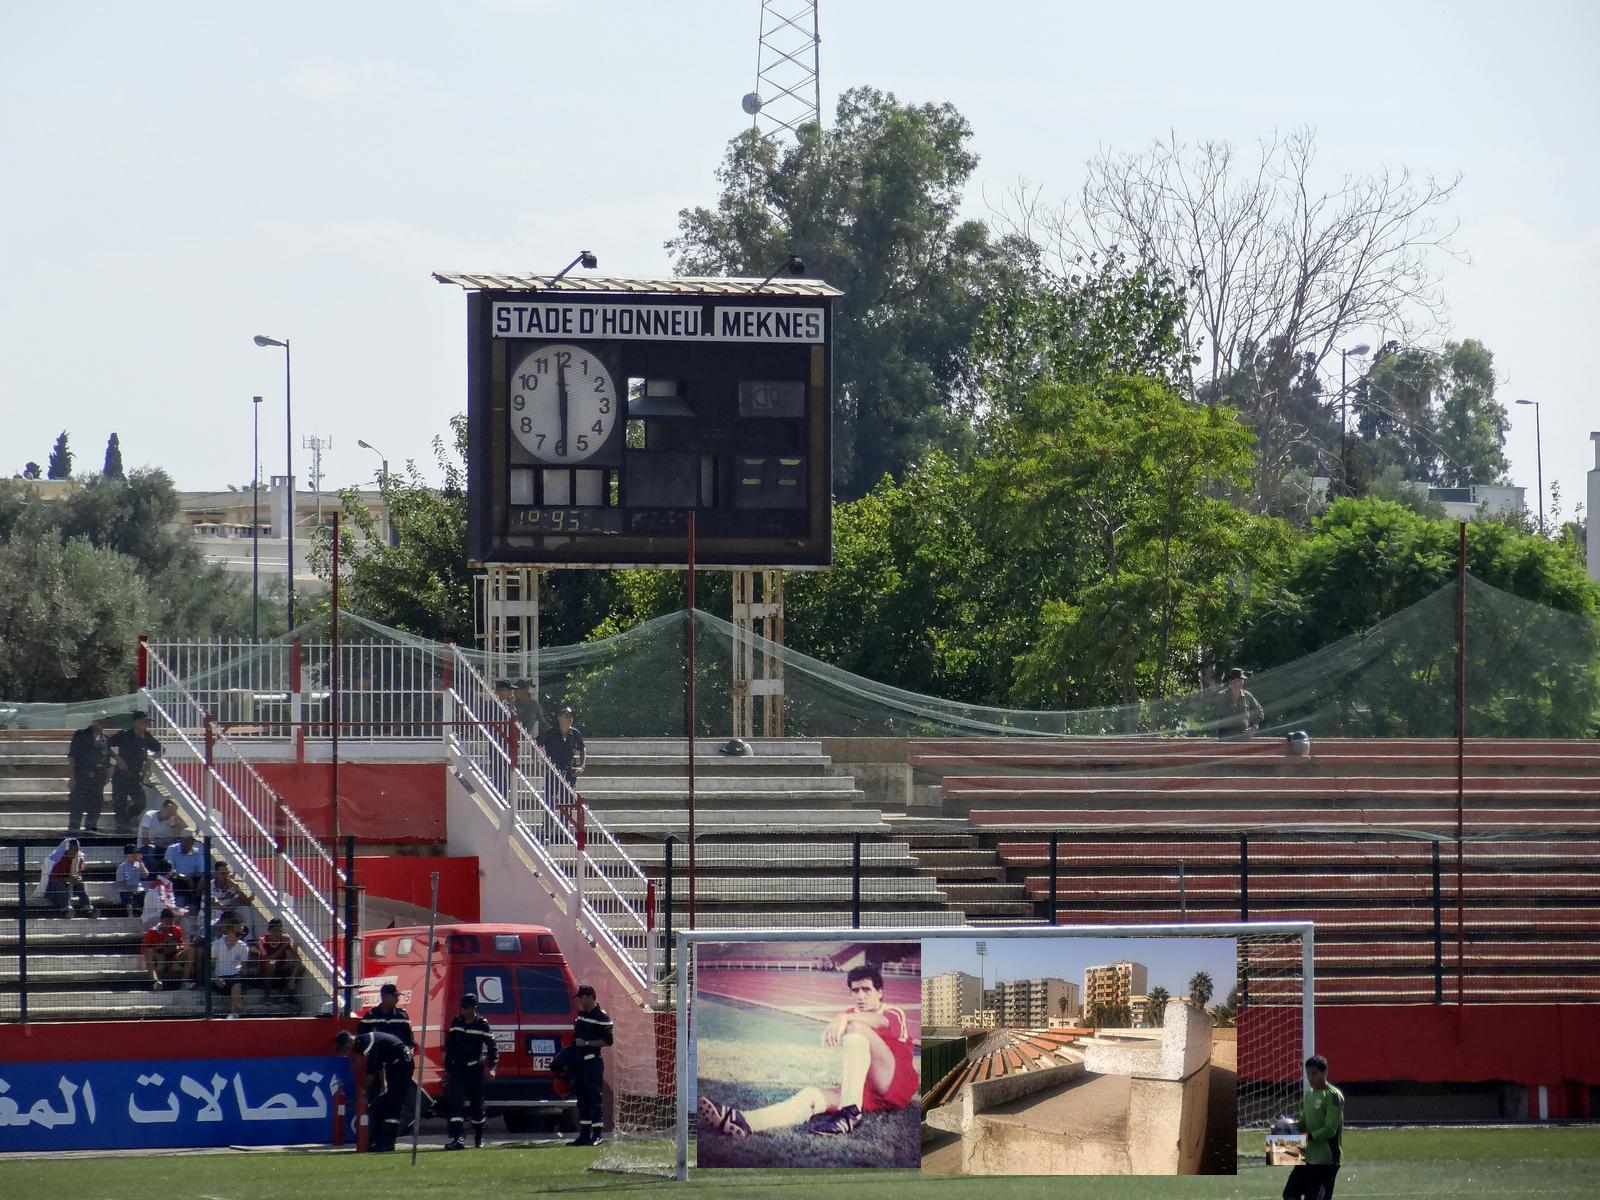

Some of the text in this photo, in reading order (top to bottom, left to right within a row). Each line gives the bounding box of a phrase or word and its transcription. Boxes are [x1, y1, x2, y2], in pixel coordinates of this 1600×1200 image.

[496, 306, 820, 338] STADE D'HONNEU MEKNES
[535, 358, 549, 374] 11
[581, 360, 589, 375] 1
[519, 374, 539, 391] 10
[594, 376, 605, 393] 2
[513, 394, 526, 411] 9
[599, 397, 610, 414] 3
[520, 416, 533, 434] 8
[591, 419, 604, 436] 4
[535, 433, 546, 450] 7
[576, 434, 589, 452] 5
